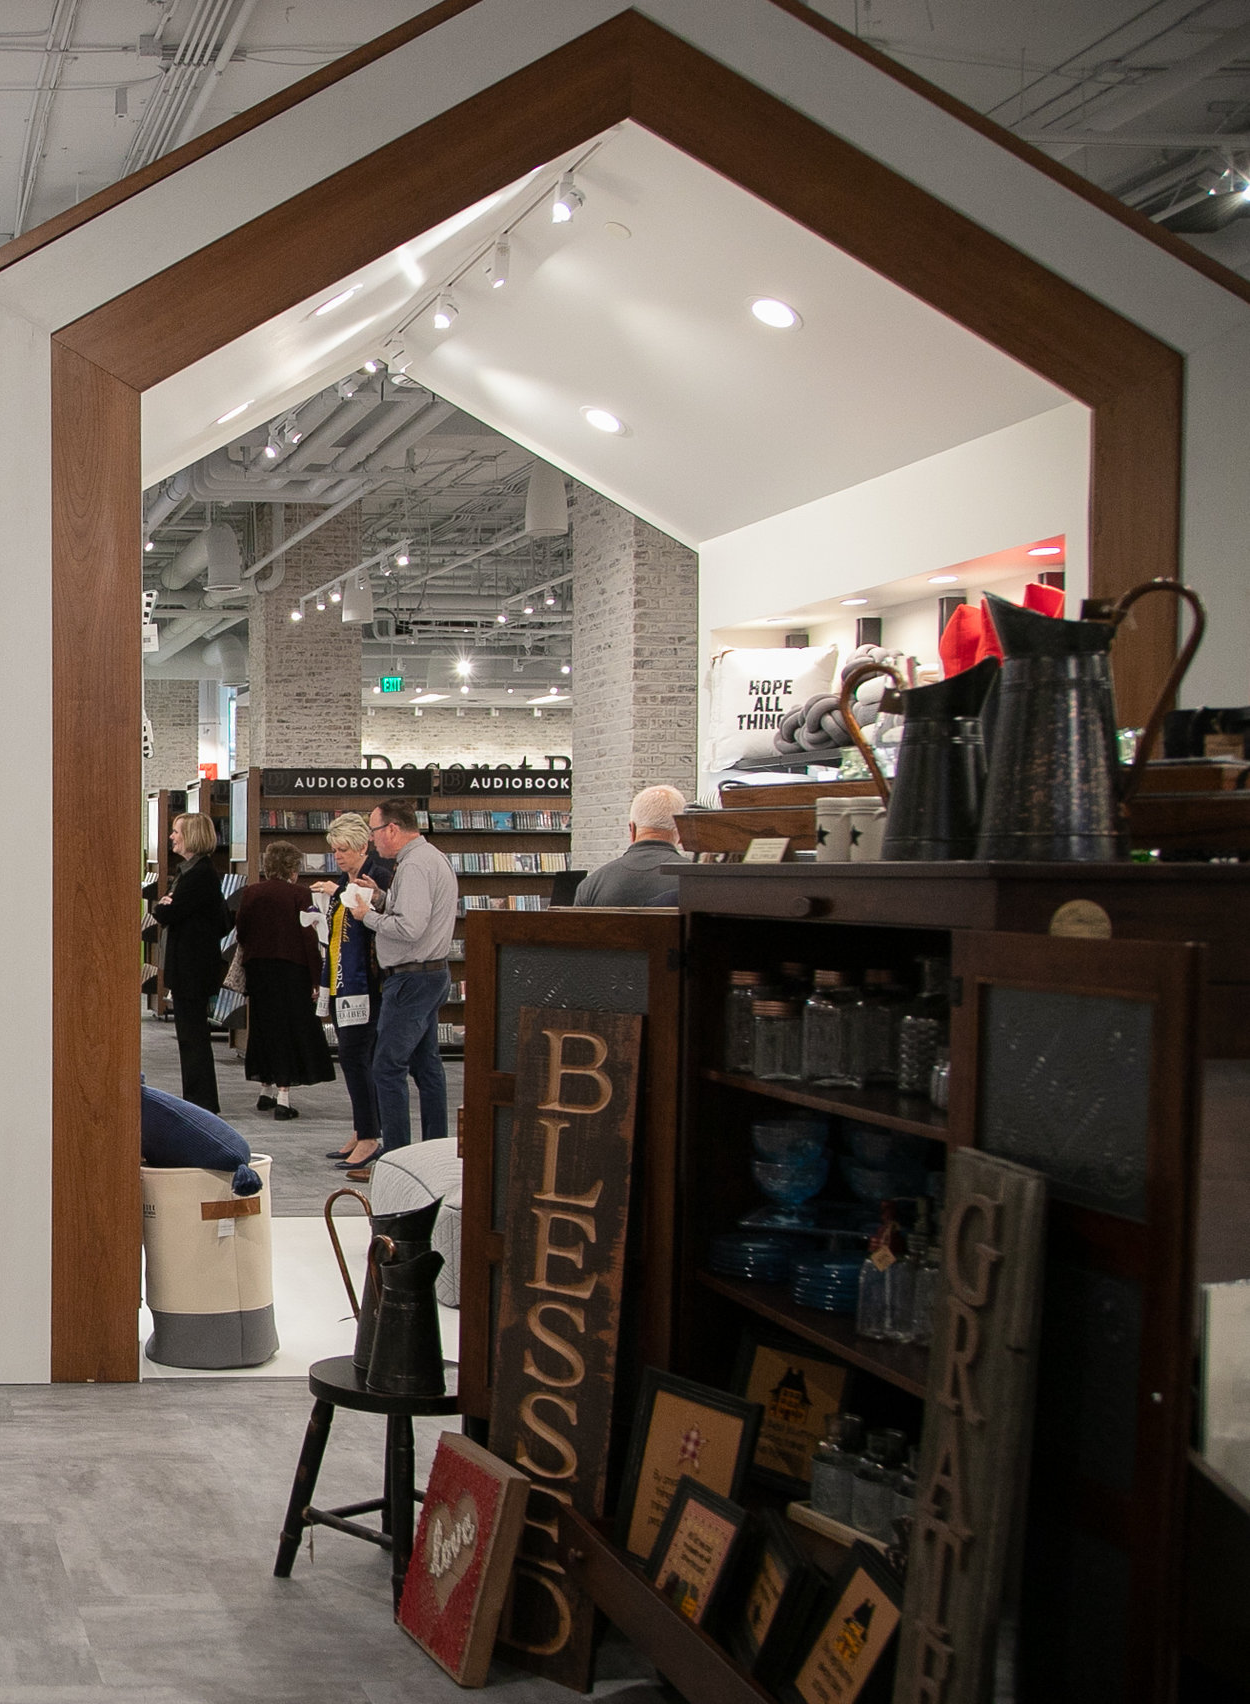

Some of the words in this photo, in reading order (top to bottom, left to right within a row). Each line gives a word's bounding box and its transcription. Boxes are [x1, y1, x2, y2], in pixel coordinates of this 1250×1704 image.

[383, 677, 402, 692] EXIT
[748, 679, 793, 695] HOPE
[753, 696, 783, 712] ALL
[737, 713, 786, 730] THIN
[294, 776, 406, 789] AUDIOBOOKS
[469, 777, 570, 789] AUDIOBOOK
[429, 1512, 476, 1578] love
